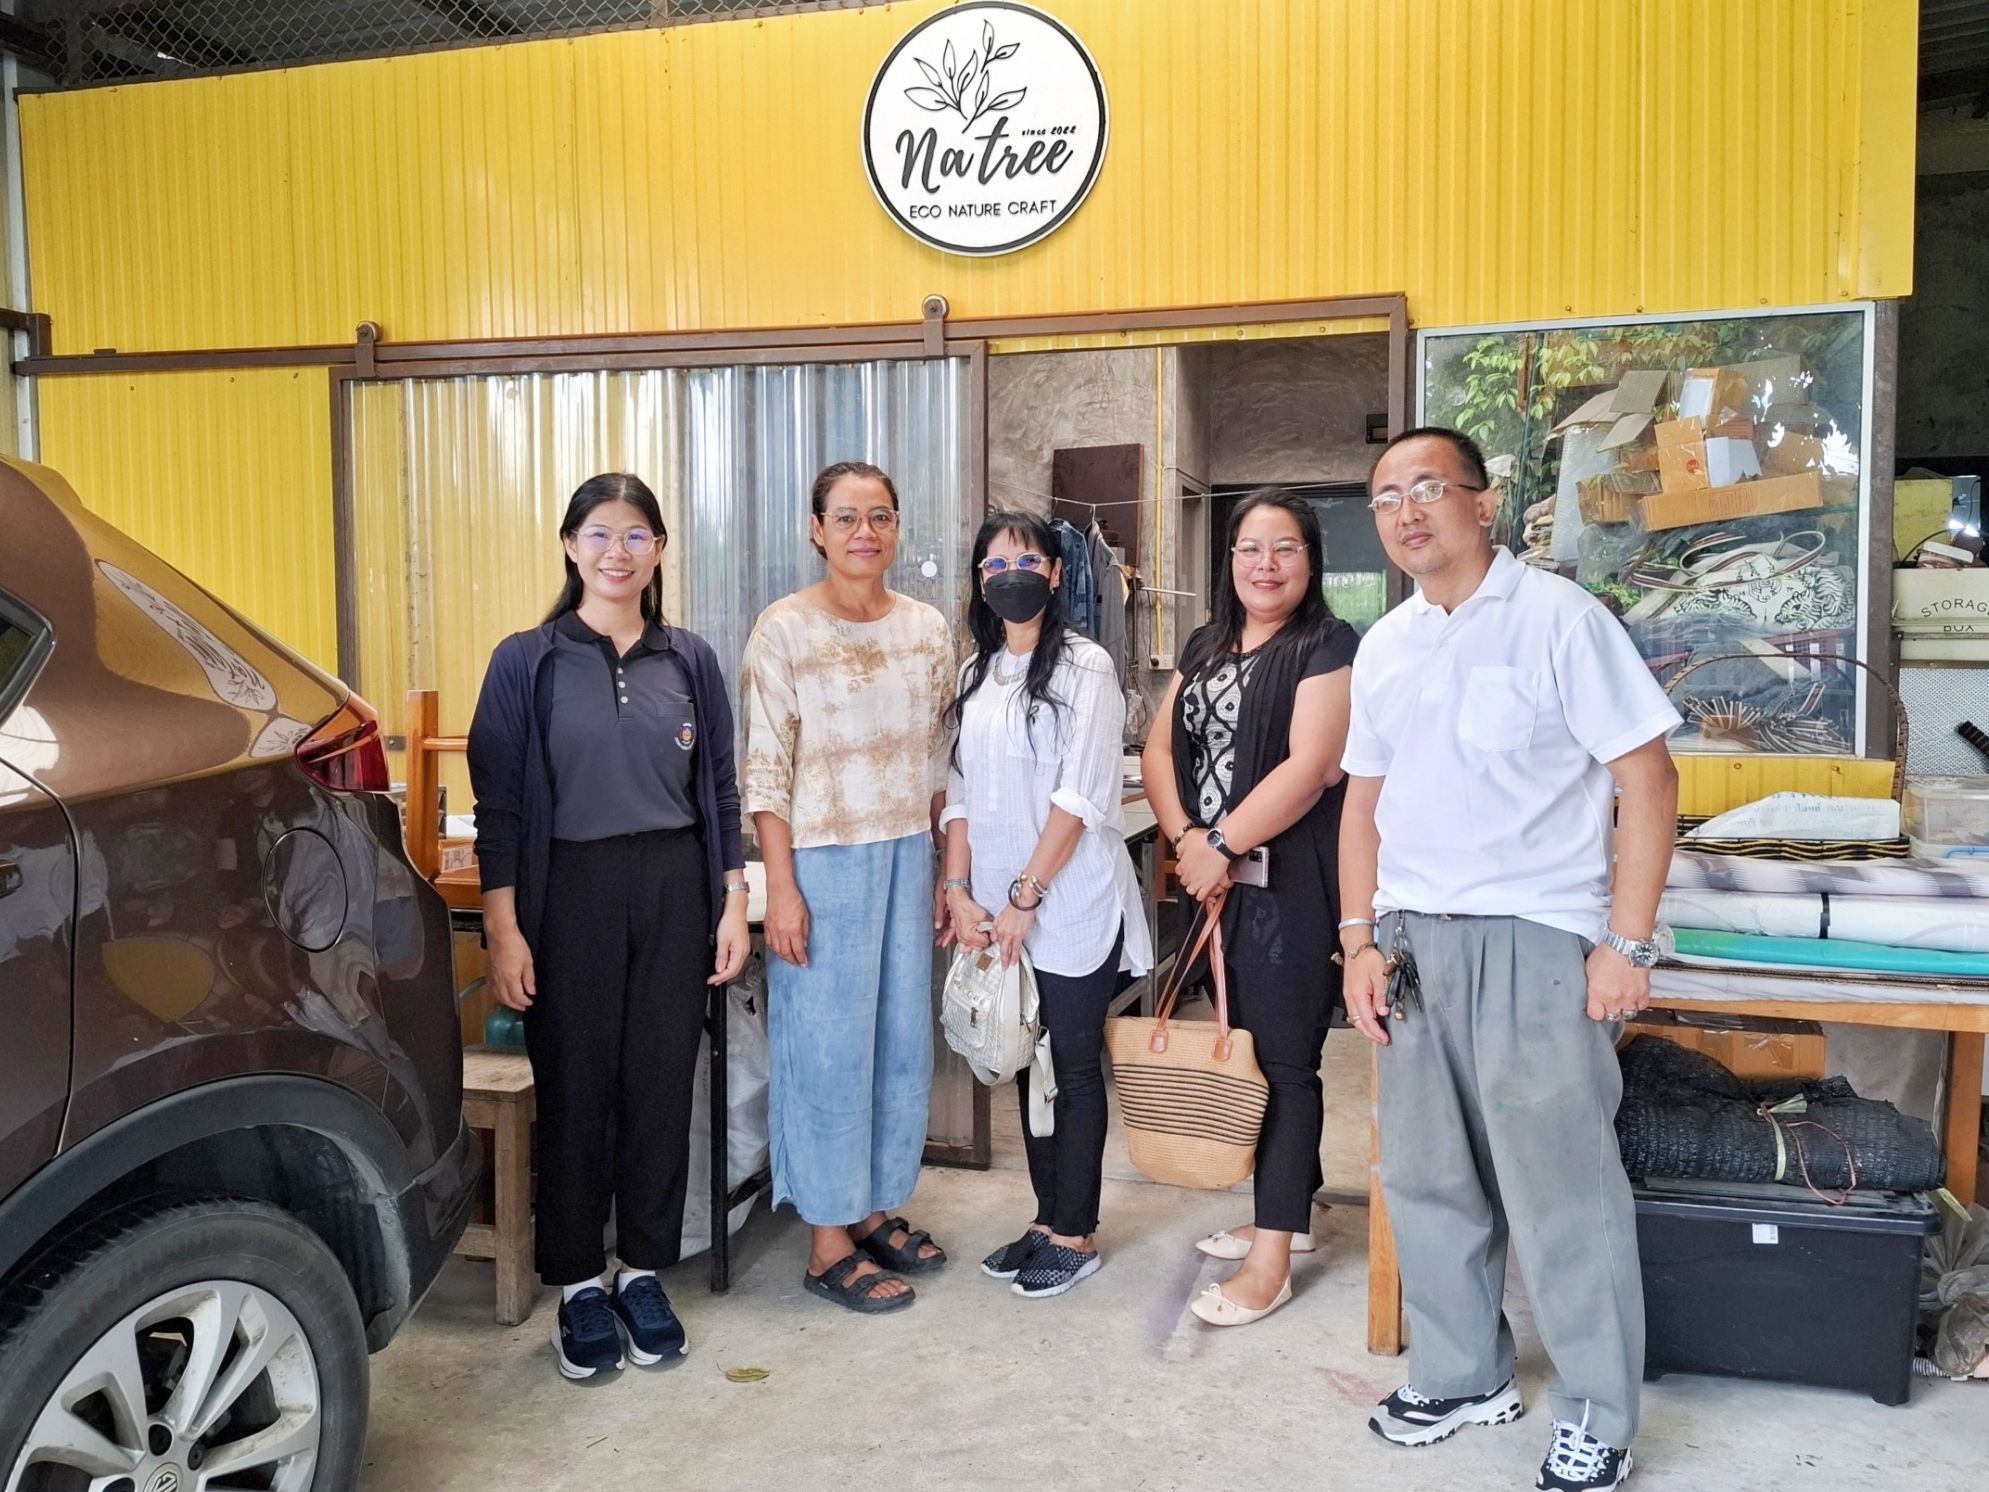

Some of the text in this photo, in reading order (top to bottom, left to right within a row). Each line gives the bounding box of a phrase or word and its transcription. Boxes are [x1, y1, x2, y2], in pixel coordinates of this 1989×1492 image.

[1021, 125, 1077, 137] since 2022
[909, 199, 1057, 220] ECO NATURE CRAFT
[1920, 598, 1989, 618] STORAG
